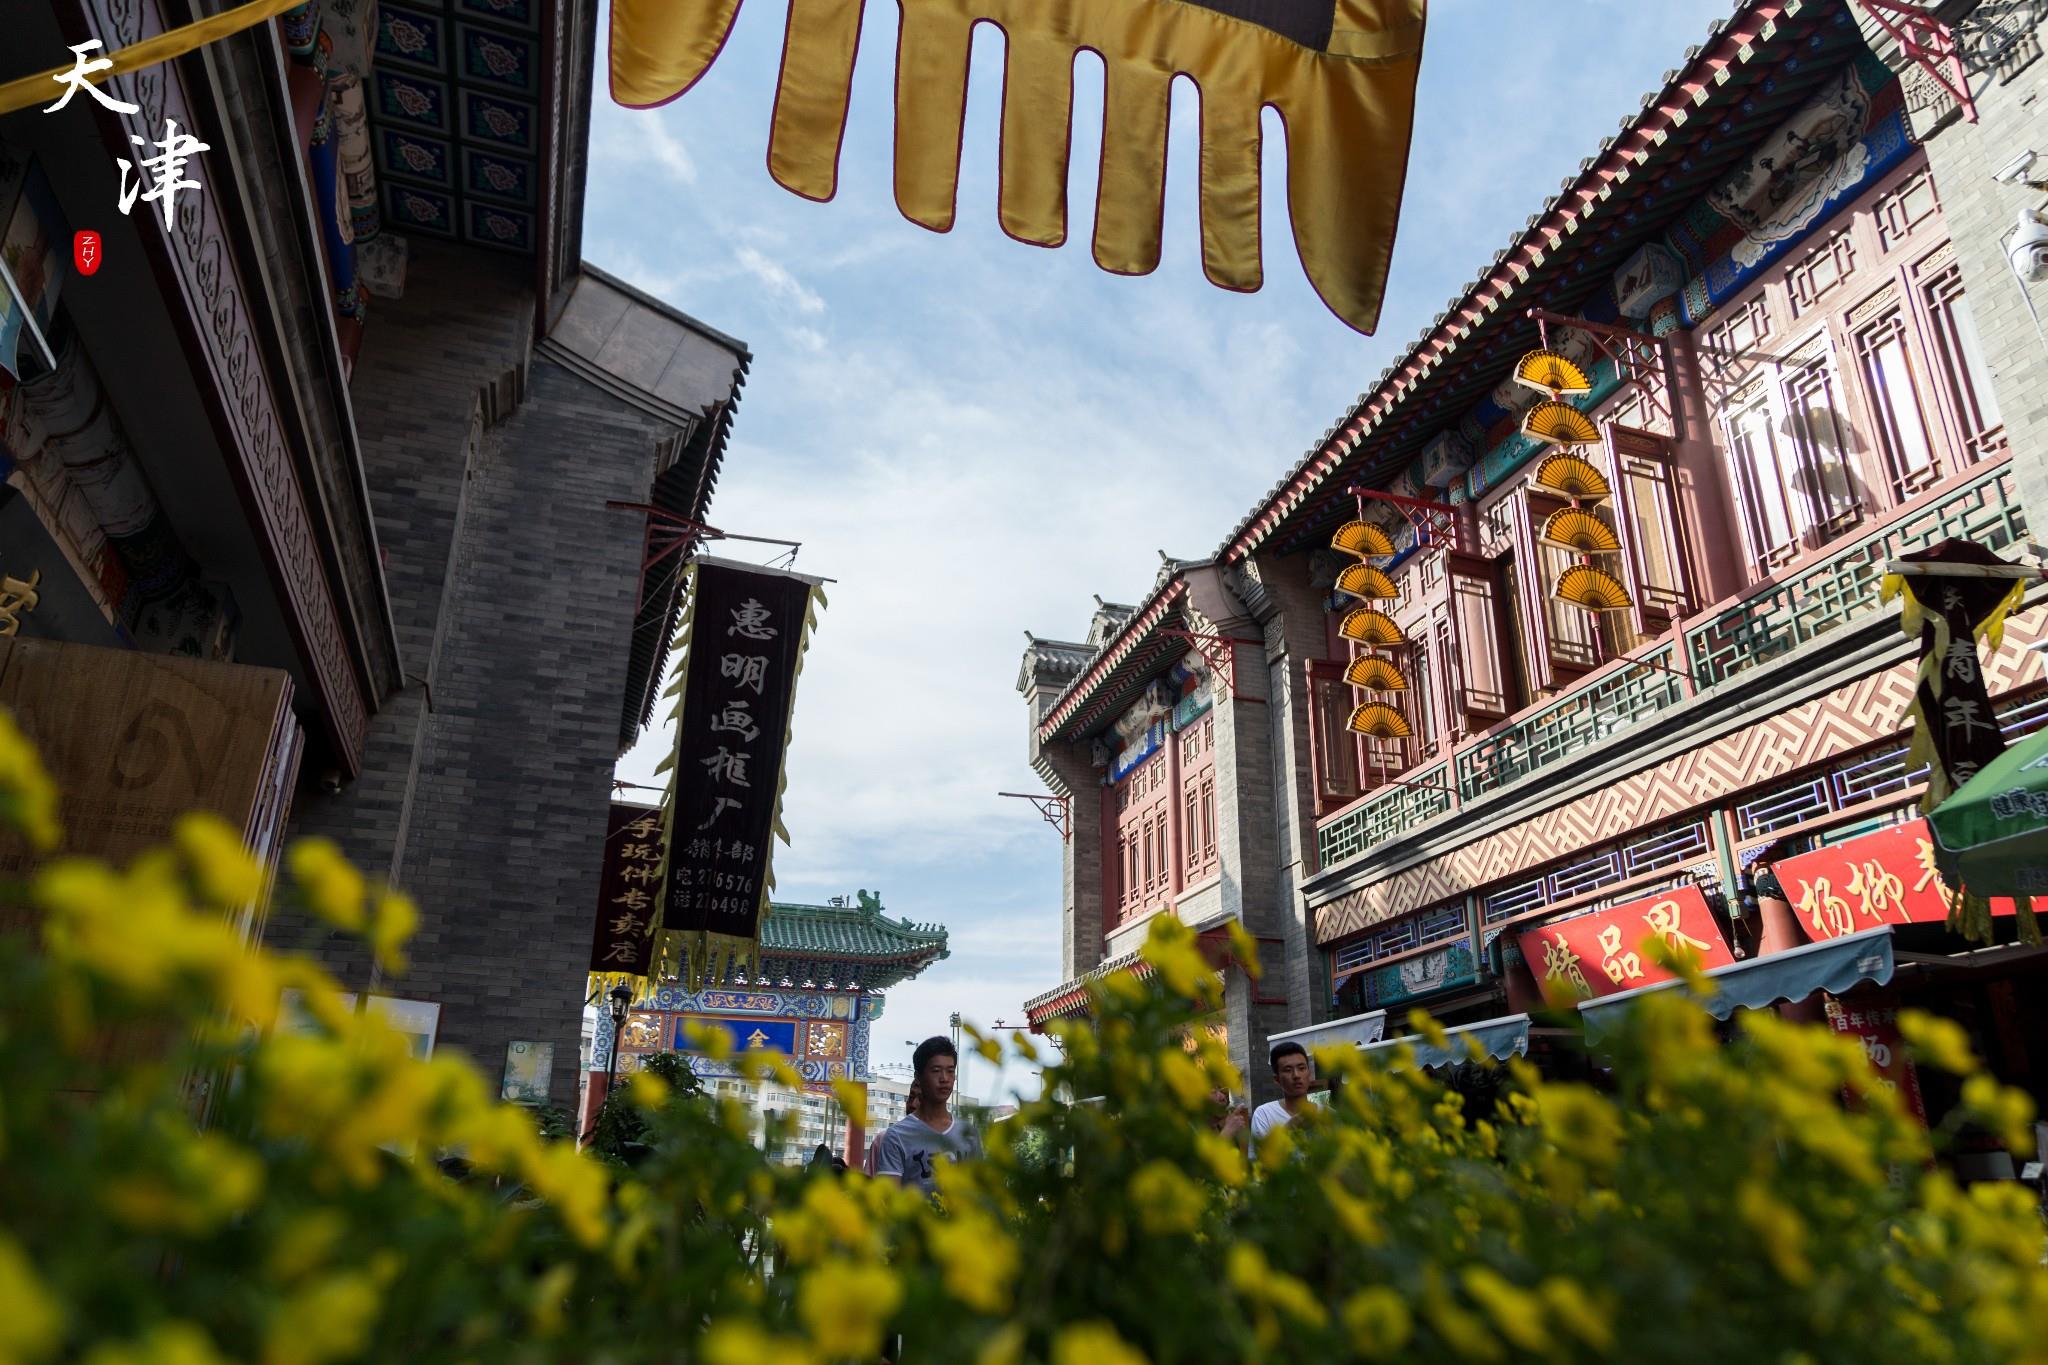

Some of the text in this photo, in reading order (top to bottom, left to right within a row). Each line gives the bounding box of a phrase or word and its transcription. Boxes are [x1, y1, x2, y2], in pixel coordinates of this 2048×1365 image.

[697, 597, 779, 830] 惠明画框厂
